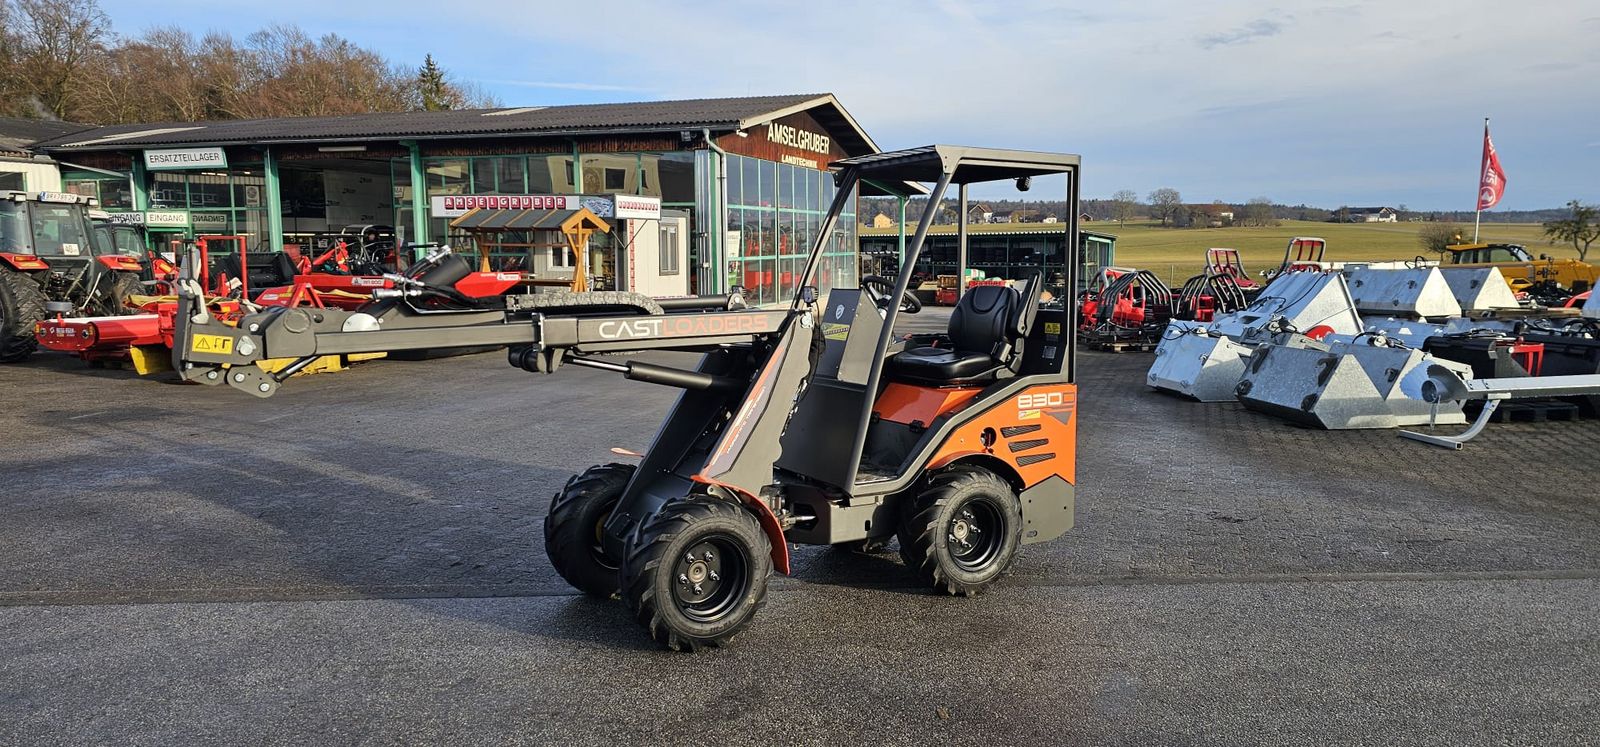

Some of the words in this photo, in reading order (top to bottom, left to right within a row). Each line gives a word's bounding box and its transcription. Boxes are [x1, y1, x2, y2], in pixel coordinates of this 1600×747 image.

[768, 122, 830, 155] AMSELGRUBER
[149, 152, 220, 164] ERSATZTEILLAGER
[781, 154, 818, 169] LANDTECHNIK
[444, 197, 566, 209] AMSELGRUBER
[149, 213, 185, 222] EINGANG
[598, 314, 769, 339] CASTLOADERS
